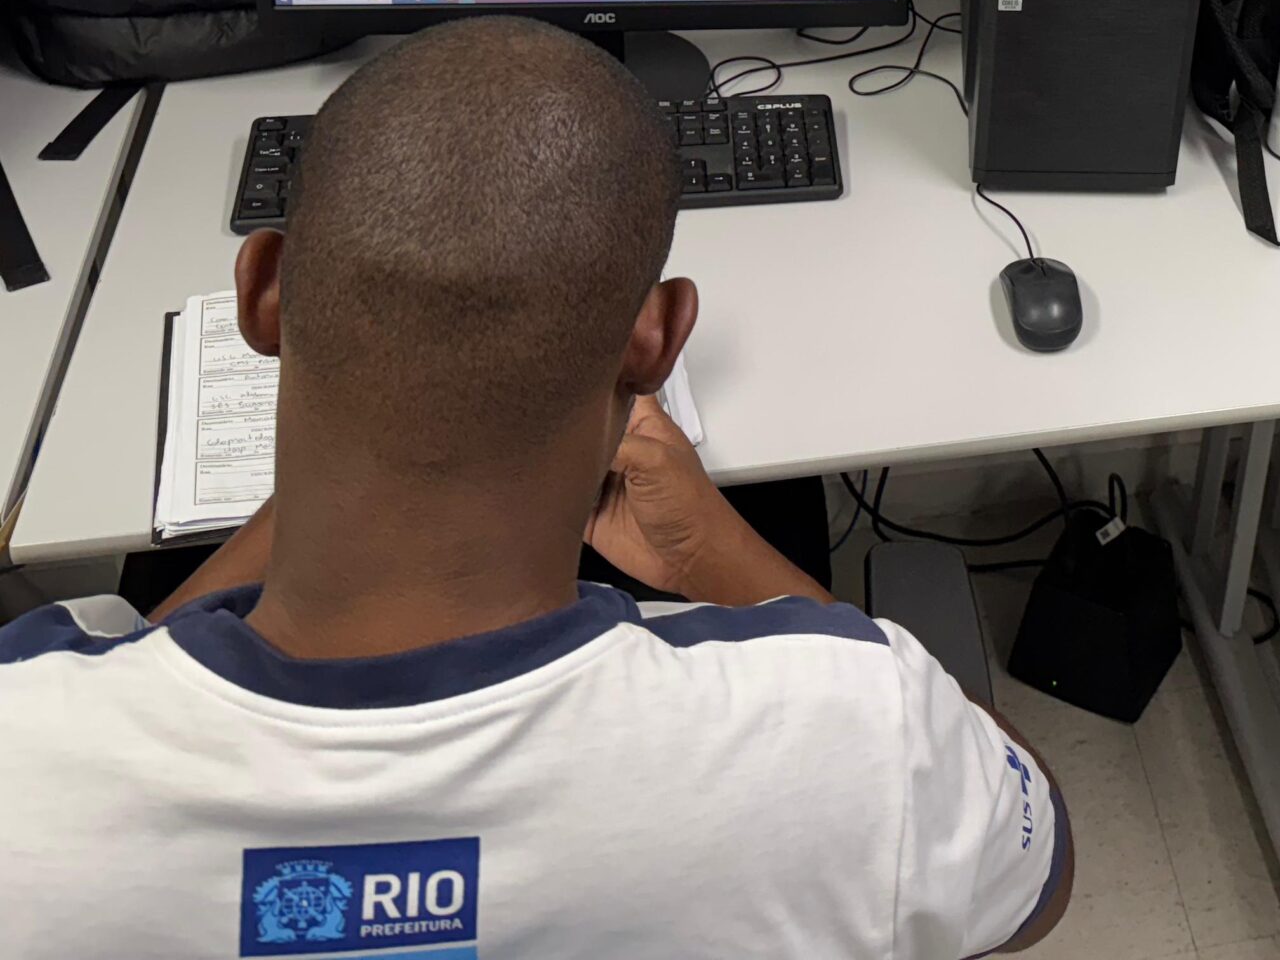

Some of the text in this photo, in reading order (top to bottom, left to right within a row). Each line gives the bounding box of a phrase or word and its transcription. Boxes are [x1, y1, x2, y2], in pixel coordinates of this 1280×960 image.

[583, 12, 616, 24] AOC
[1021, 801, 1033, 852] SUS
[361, 869, 465, 920] RIO
[359, 917, 464, 938] PREFEITURA
